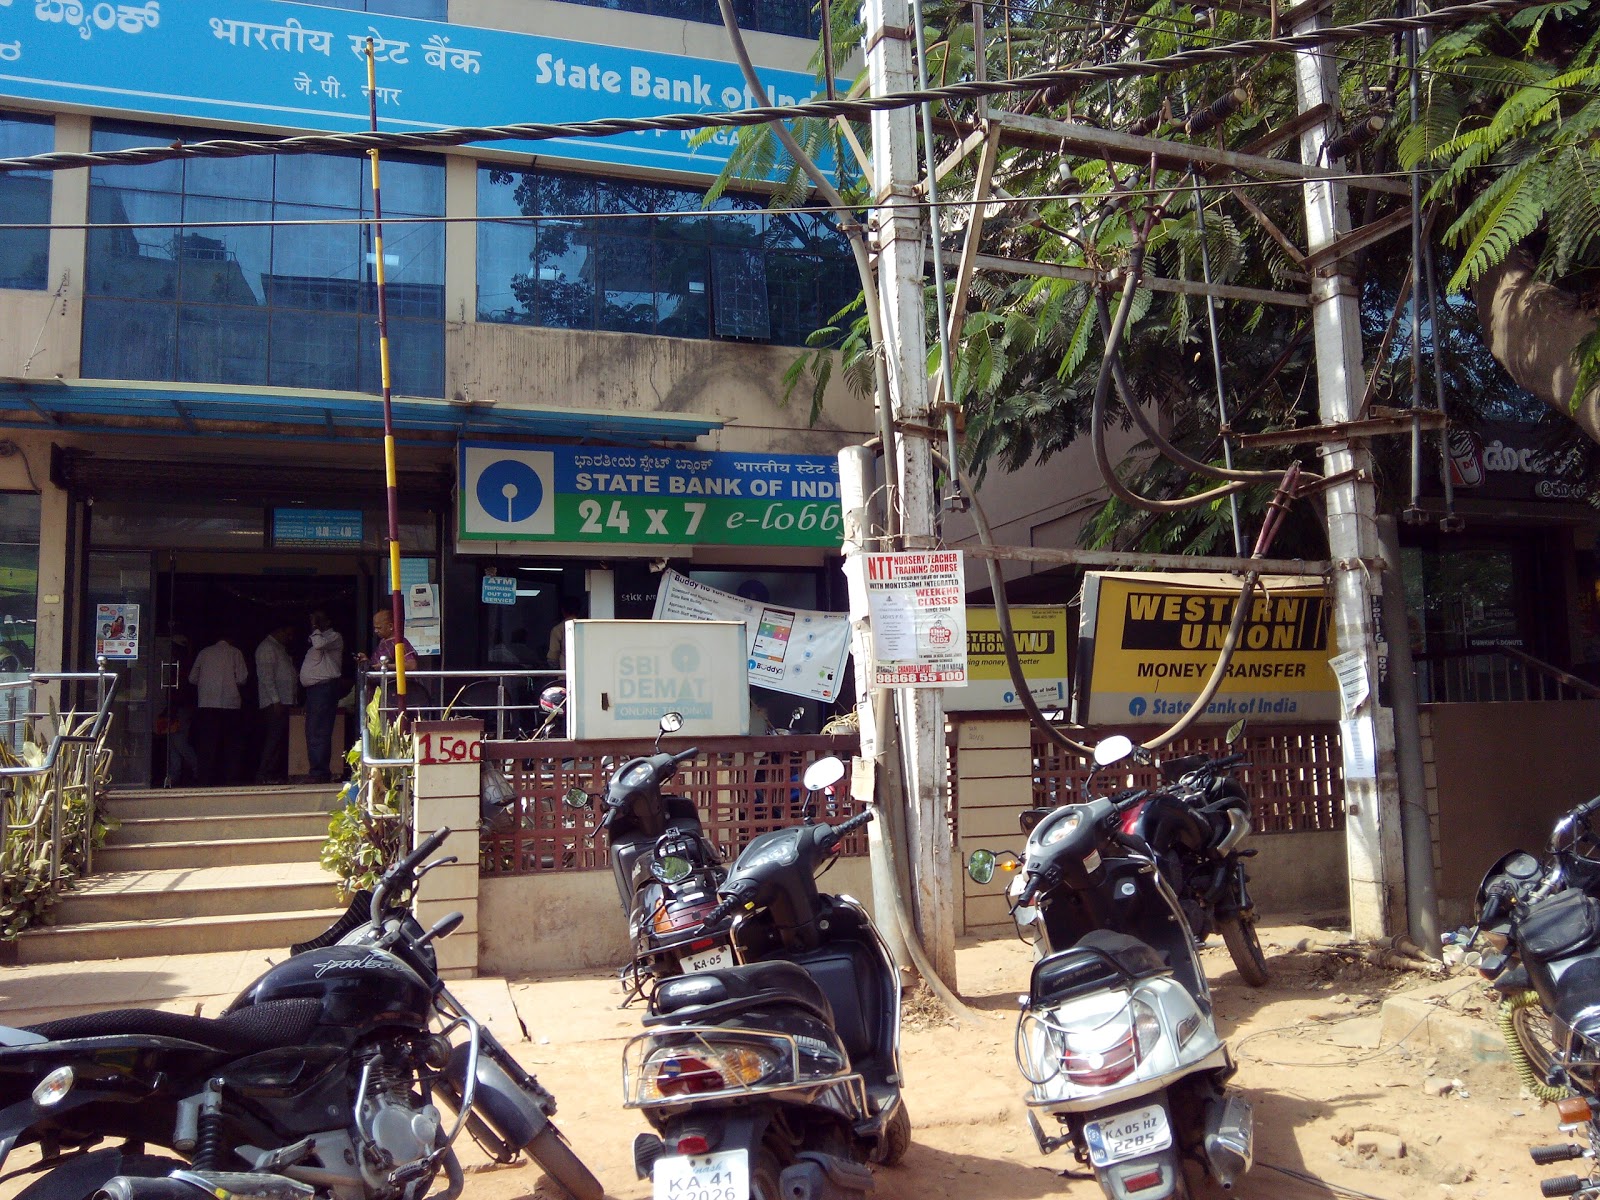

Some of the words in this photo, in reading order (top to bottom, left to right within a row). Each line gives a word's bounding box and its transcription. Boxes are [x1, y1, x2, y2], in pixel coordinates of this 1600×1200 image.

[209, 17, 334, 57] भारतीय
[421, 34, 482, 75] बैंक
[536, 53, 621, 93] State
[631, 66, 712, 106] Bank
[575, 454, 636, 469] ಭಾರತೀಯ
[675, 458, 714, 474] ಬ್ಯಾಂಕ್
[734, 460, 791, 474] भारतीय
[795, 461, 826, 475] स्टेट
[576, 473, 660, 493] STATE
[669, 476, 742, 496] BANK
[750, 479, 783, 497] OF
[792, 481, 842, 498] INDI
[578, 499, 630, 534] 24
[684, 502, 707, 536] 7
[726, 503, 844, 540] e-lobb
[868, 556, 893, 580] NTT
[894, 555, 925, 565] NURSERY
[927, 553, 958, 563] TEACHER
[895, 565, 927, 575] TRAINING
[930, 563, 958, 573] COURSE
[674, 574, 699, 590] Buddy
[916, 587, 959, 597] WEEKEND
[918, 596, 959, 607] CLASSES
[619, 656, 659, 676] SBI
[981, 659, 1006, 667] money
[1137, 663, 1208, 678] MONEY
[1212, 663, 1306, 678] RANSFER
[919, 672, 937, 682] 55
[939, 671, 964, 681] 100
[619, 677, 705, 699] DEMAT
[621, 706, 660, 716] ONLINE
[1206, 699, 1238, 714] ank
[1239, 698, 1255, 716] of
[1259, 697, 1298, 714] India
[419, 733, 480, 765] 1500
[1105, 1128, 1124, 1141] KA
[1125, 1122, 1140, 1134] 05
[1143, 1117, 1158, 1130] HZ
[1114, 1131, 1155, 1153] 2285
